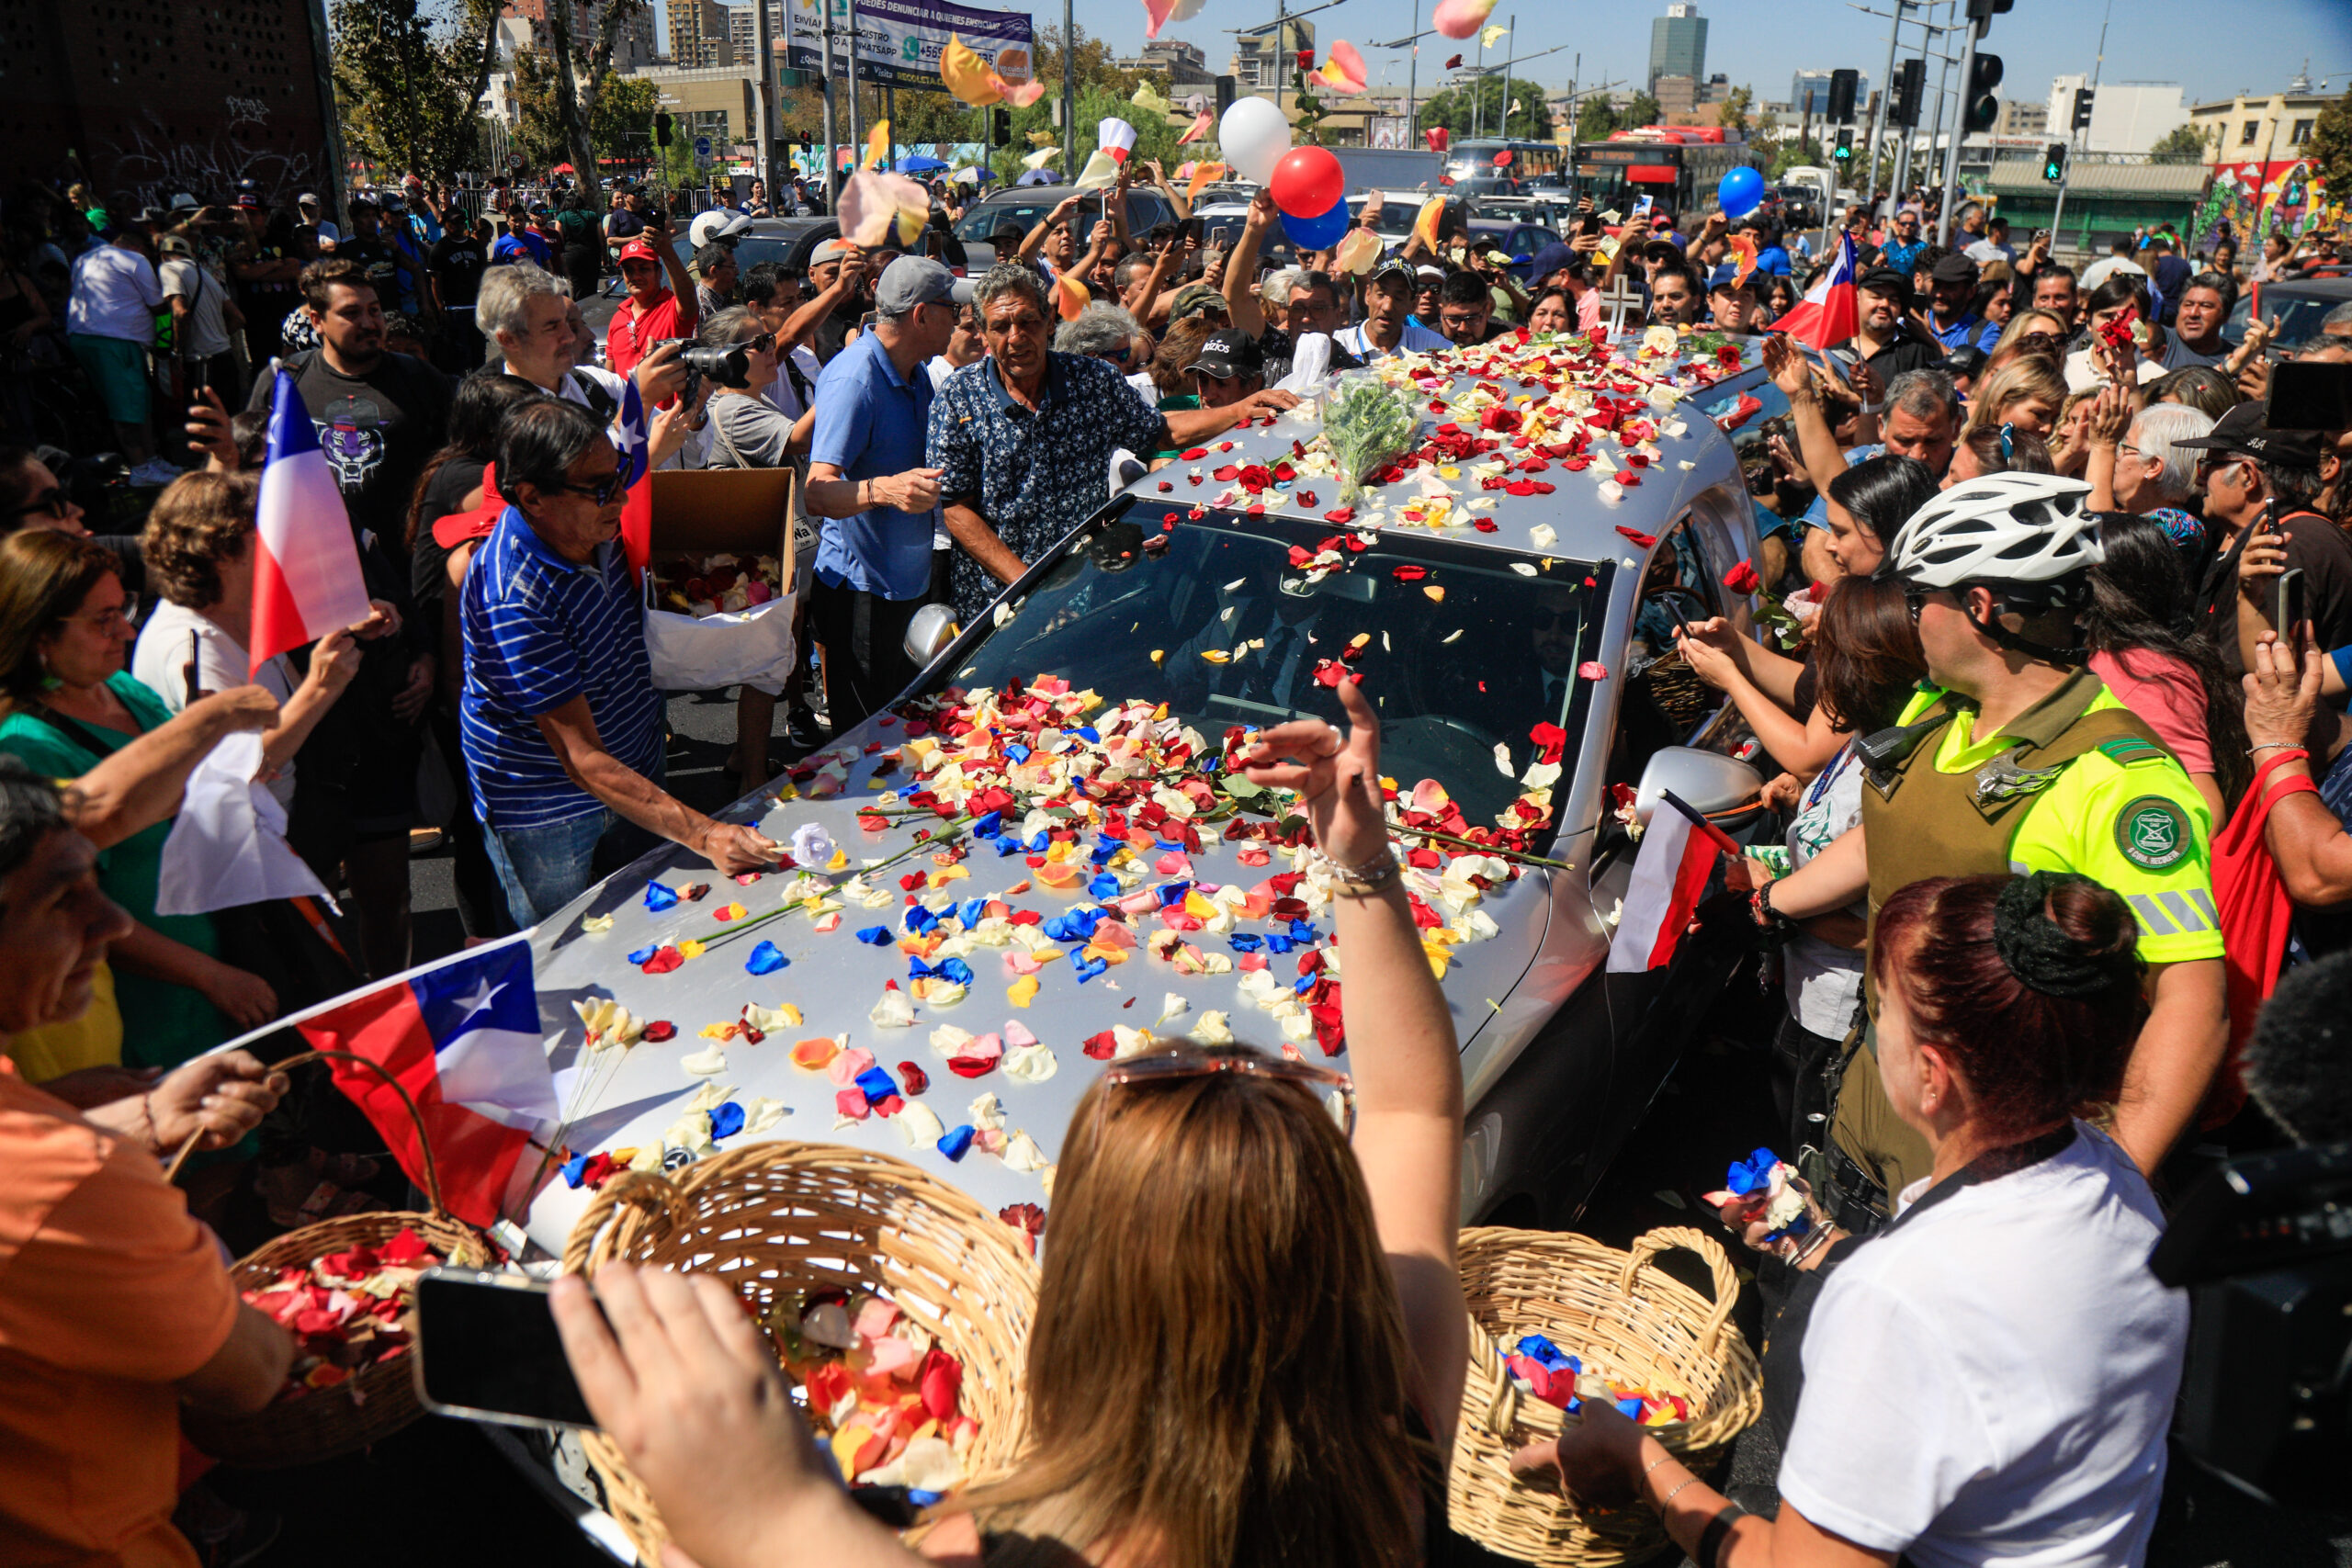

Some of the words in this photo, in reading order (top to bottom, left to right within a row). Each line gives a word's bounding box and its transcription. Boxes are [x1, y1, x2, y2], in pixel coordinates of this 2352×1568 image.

[888, 3, 929, 18] DENUNCIAR
[930, 9, 935, 19] A
[935, 12, 965, 26] QUIENES
[965, 17, 1001, 30] ENSUCIAN?
[874, 65, 893, 79] Visita
[897, 72, 944, 85] RECOLETA.C
[511, 157, 521, 165] 50
[795, 528, 810, 540] Na
